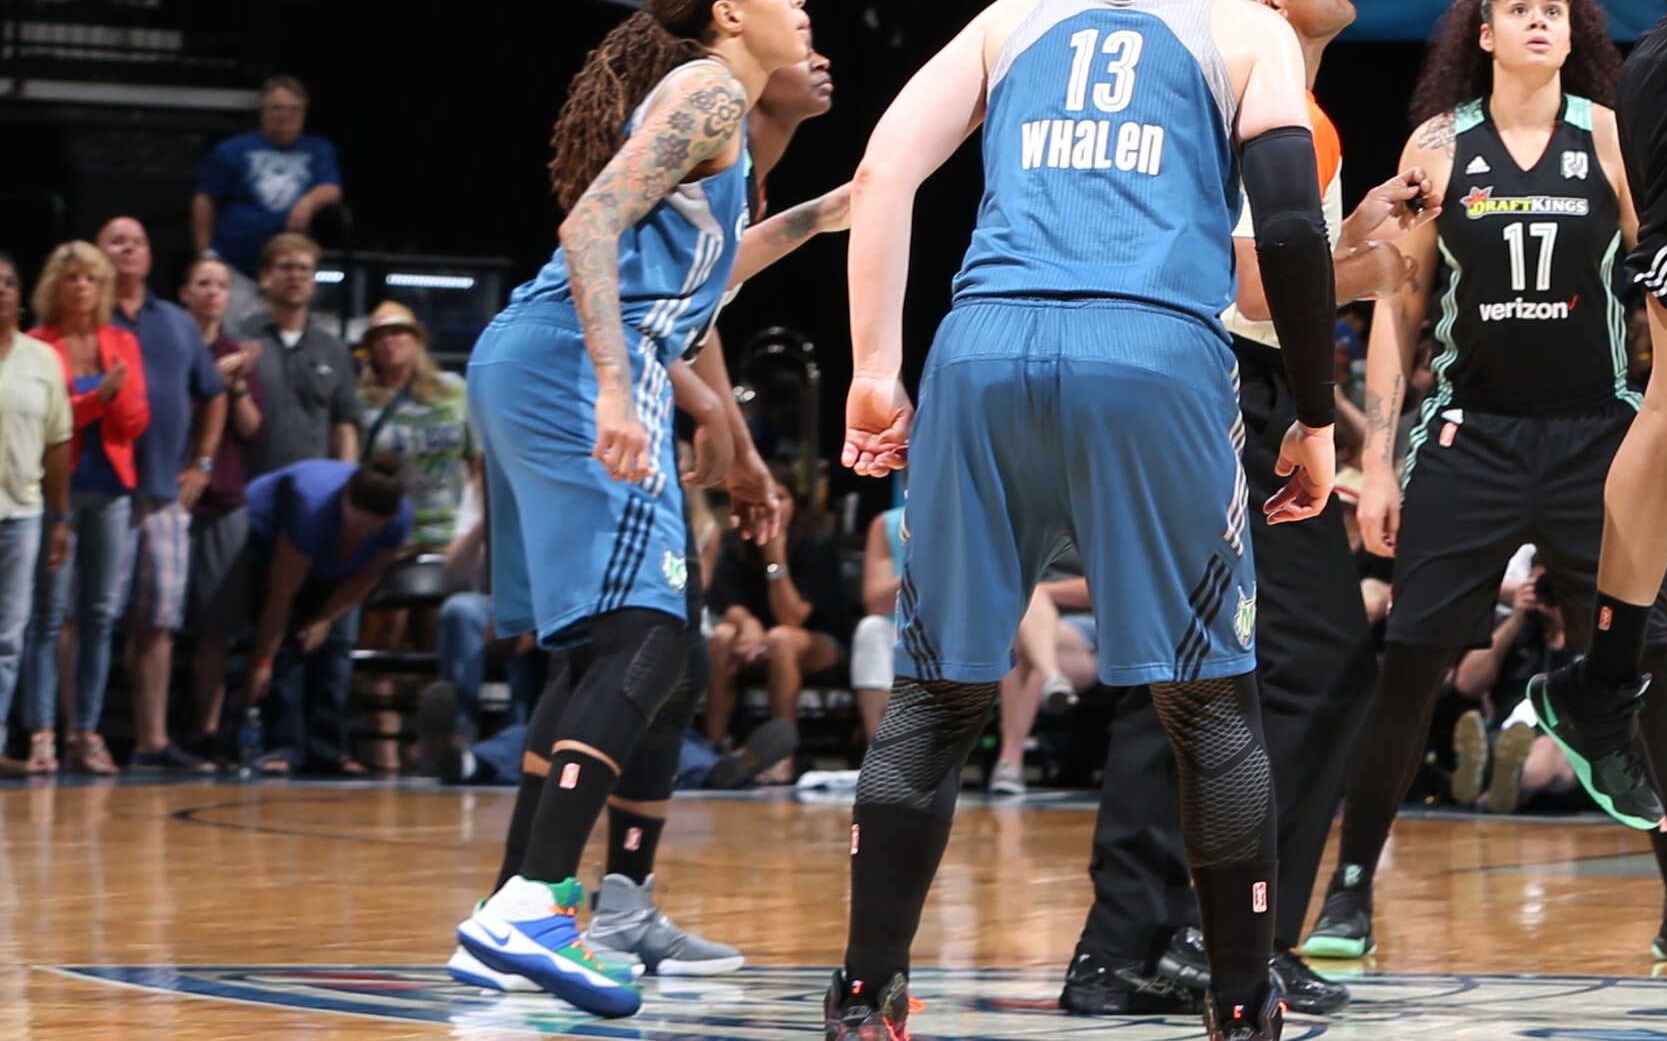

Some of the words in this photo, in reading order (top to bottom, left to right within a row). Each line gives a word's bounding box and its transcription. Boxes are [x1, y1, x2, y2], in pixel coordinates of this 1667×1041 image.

[1065, 28, 1144, 113] 13
[1468, 195, 1589, 217] DRAFTKINGS
[1502, 221, 1559, 292] 17
[1478, 296, 1569, 323] verizon
